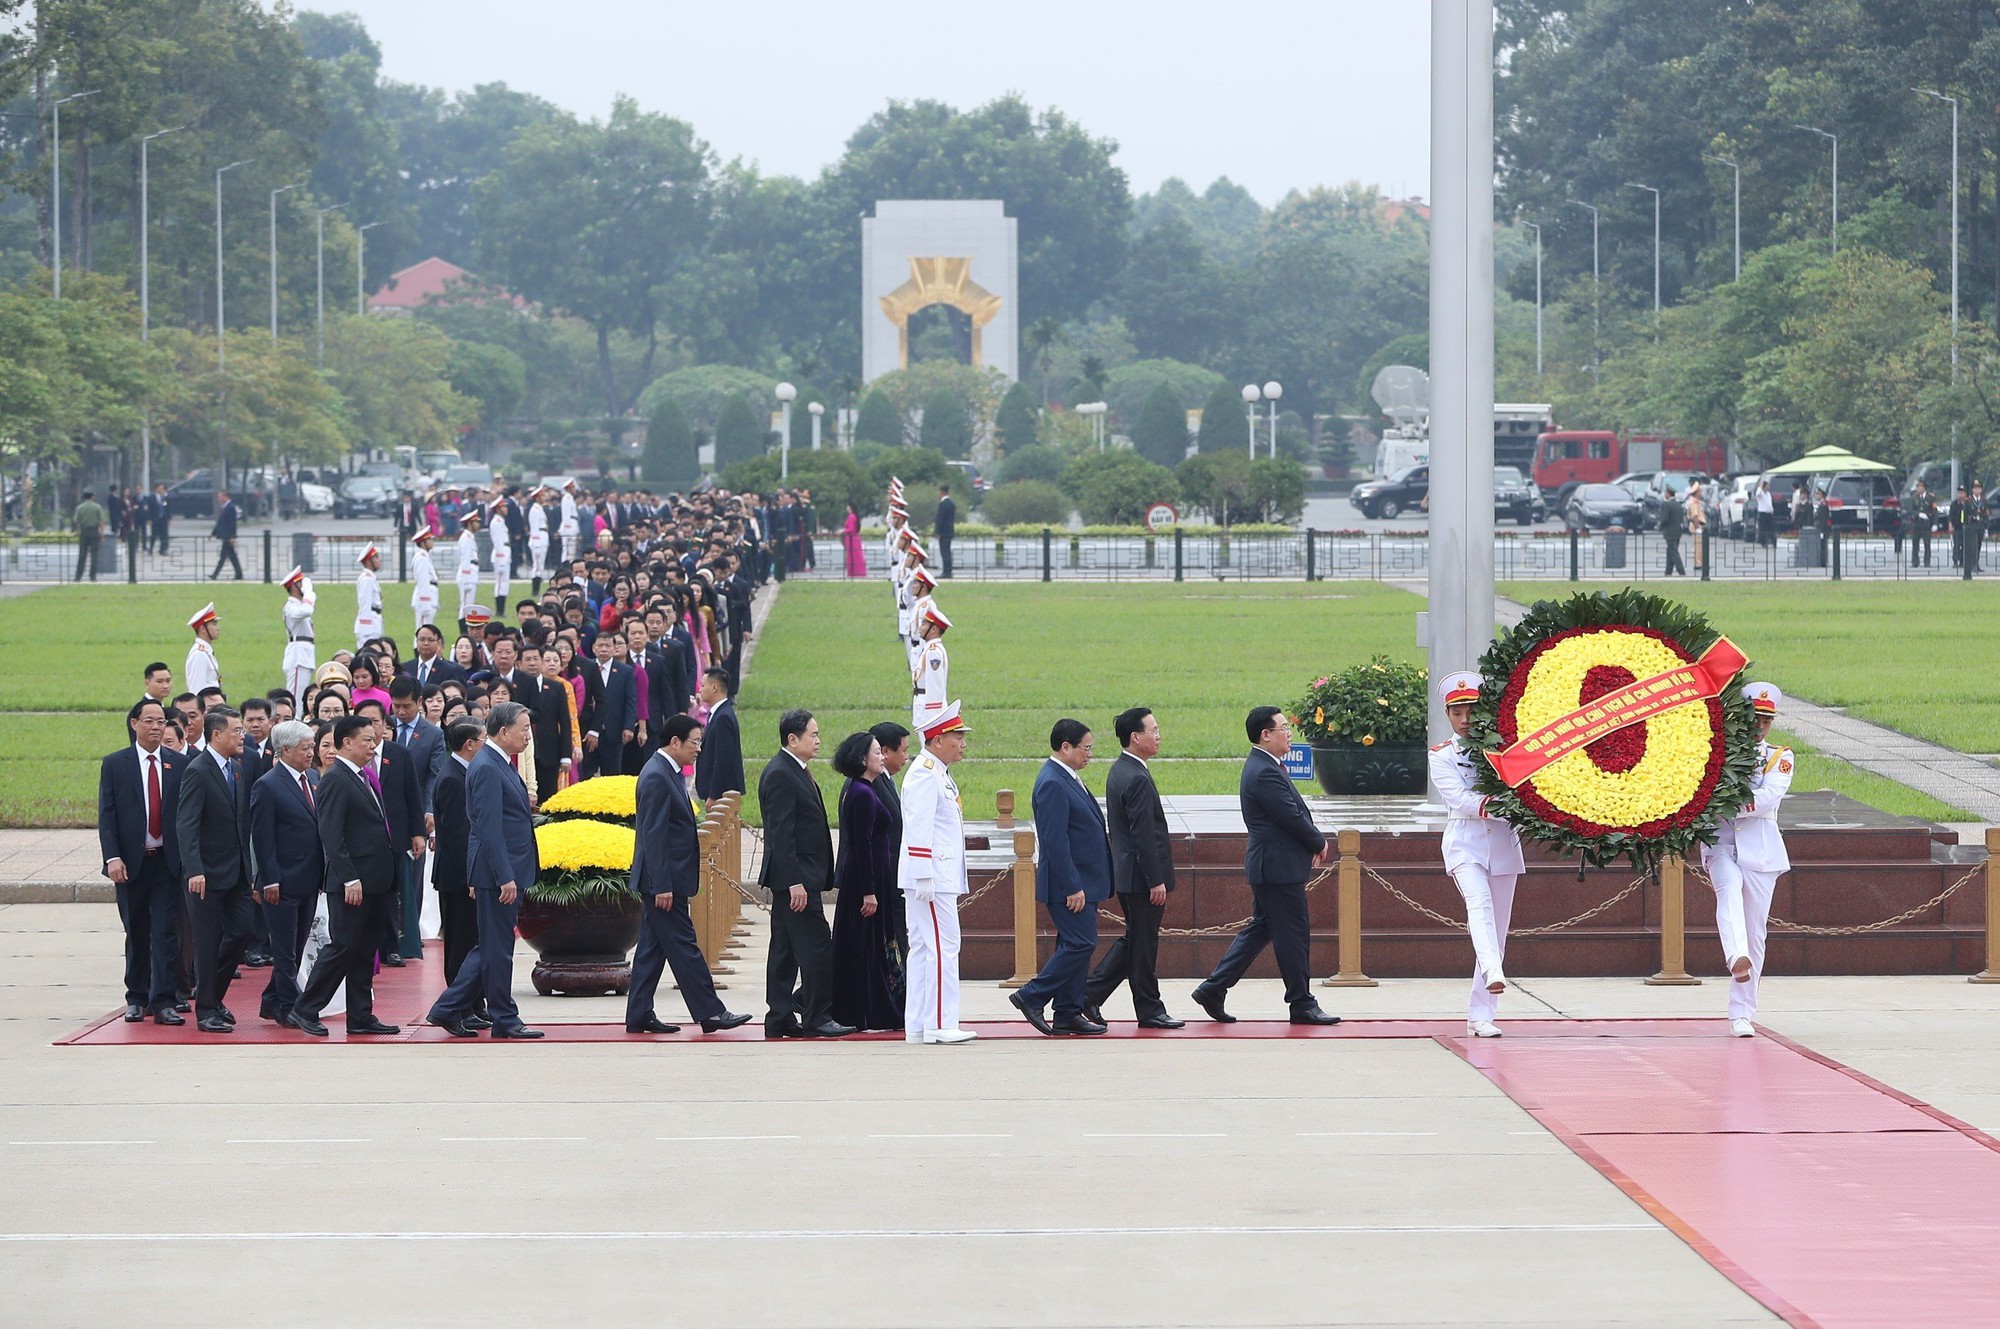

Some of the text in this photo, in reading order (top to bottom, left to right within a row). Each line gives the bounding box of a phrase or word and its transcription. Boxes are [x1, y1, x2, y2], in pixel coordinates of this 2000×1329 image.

[1602, 697, 1625, 713] TỊCH
[1633, 685, 1652, 700] CHÍ
[1647, 678, 1674, 694] MINH
[1607, 716, 1622, 728] VIỆT
